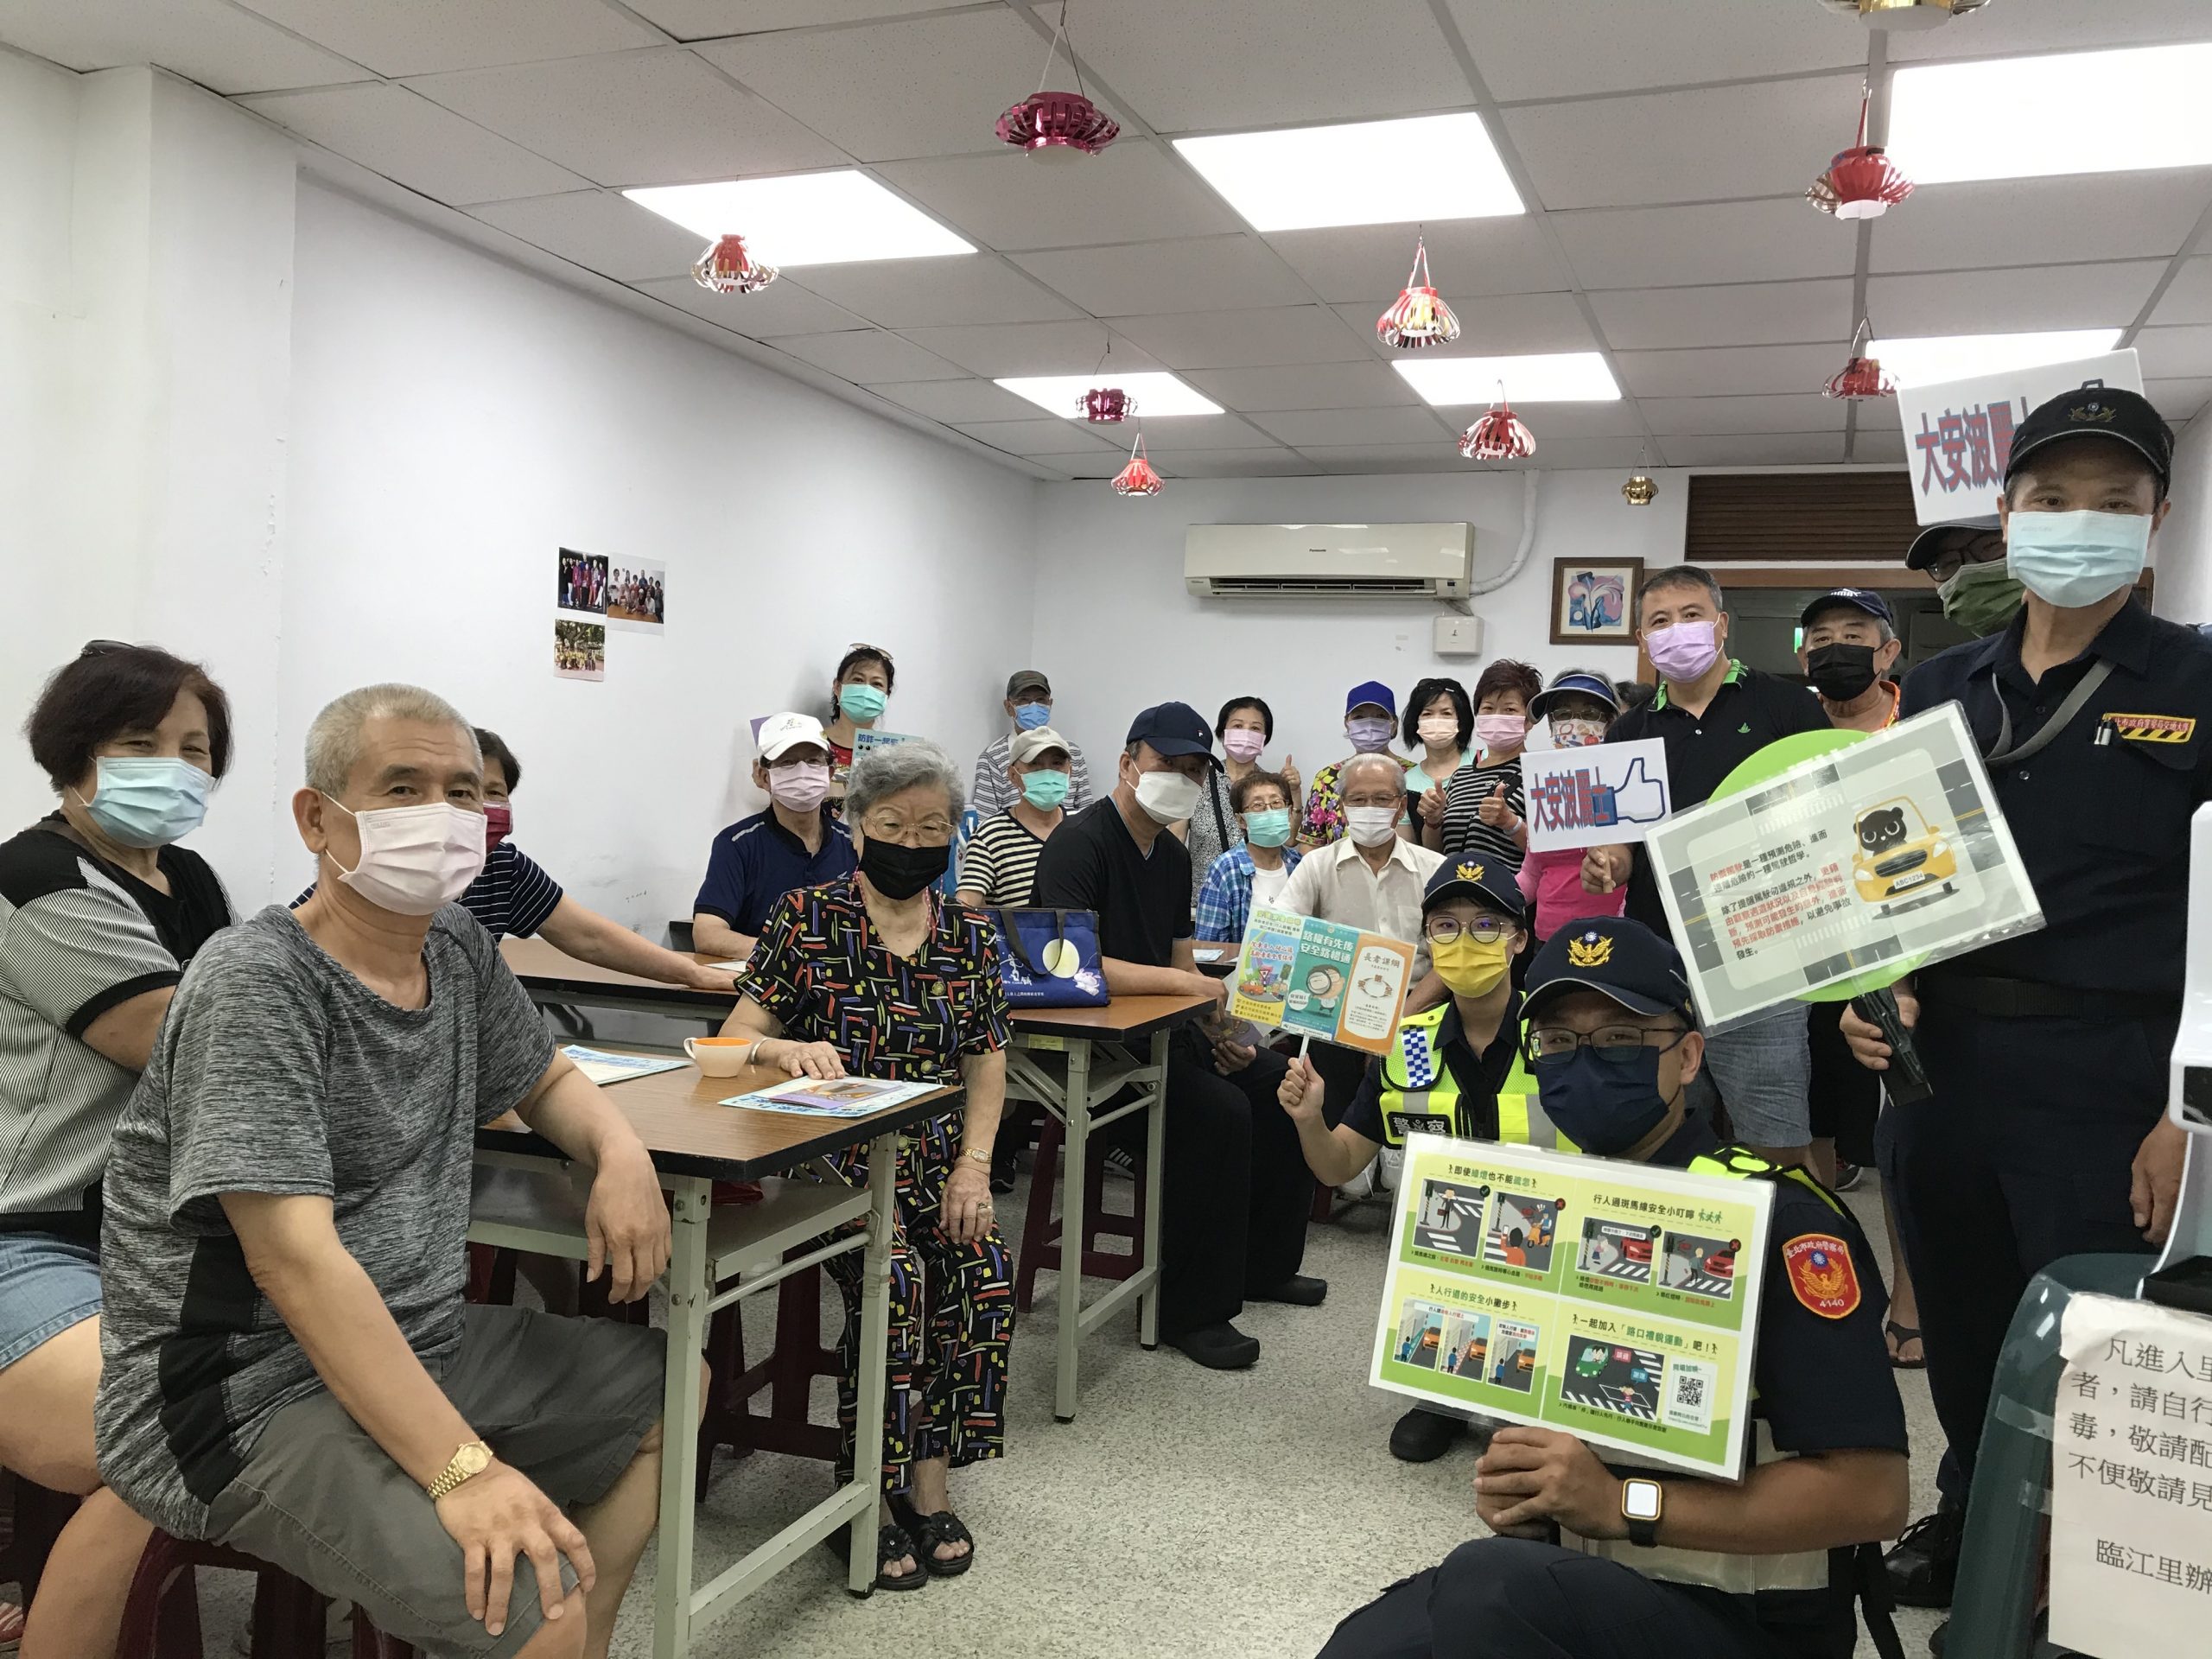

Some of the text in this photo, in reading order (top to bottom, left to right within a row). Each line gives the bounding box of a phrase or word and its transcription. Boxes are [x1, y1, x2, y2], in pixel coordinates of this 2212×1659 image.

[1896, 873, 1923, 887] ABC1234
[1820, 1299, 1844, 1307] 4140
[2068, 1452, 2212, 1511] 不便敬請見
[2096, 1537, 2212, 1595] 臨江里辦
